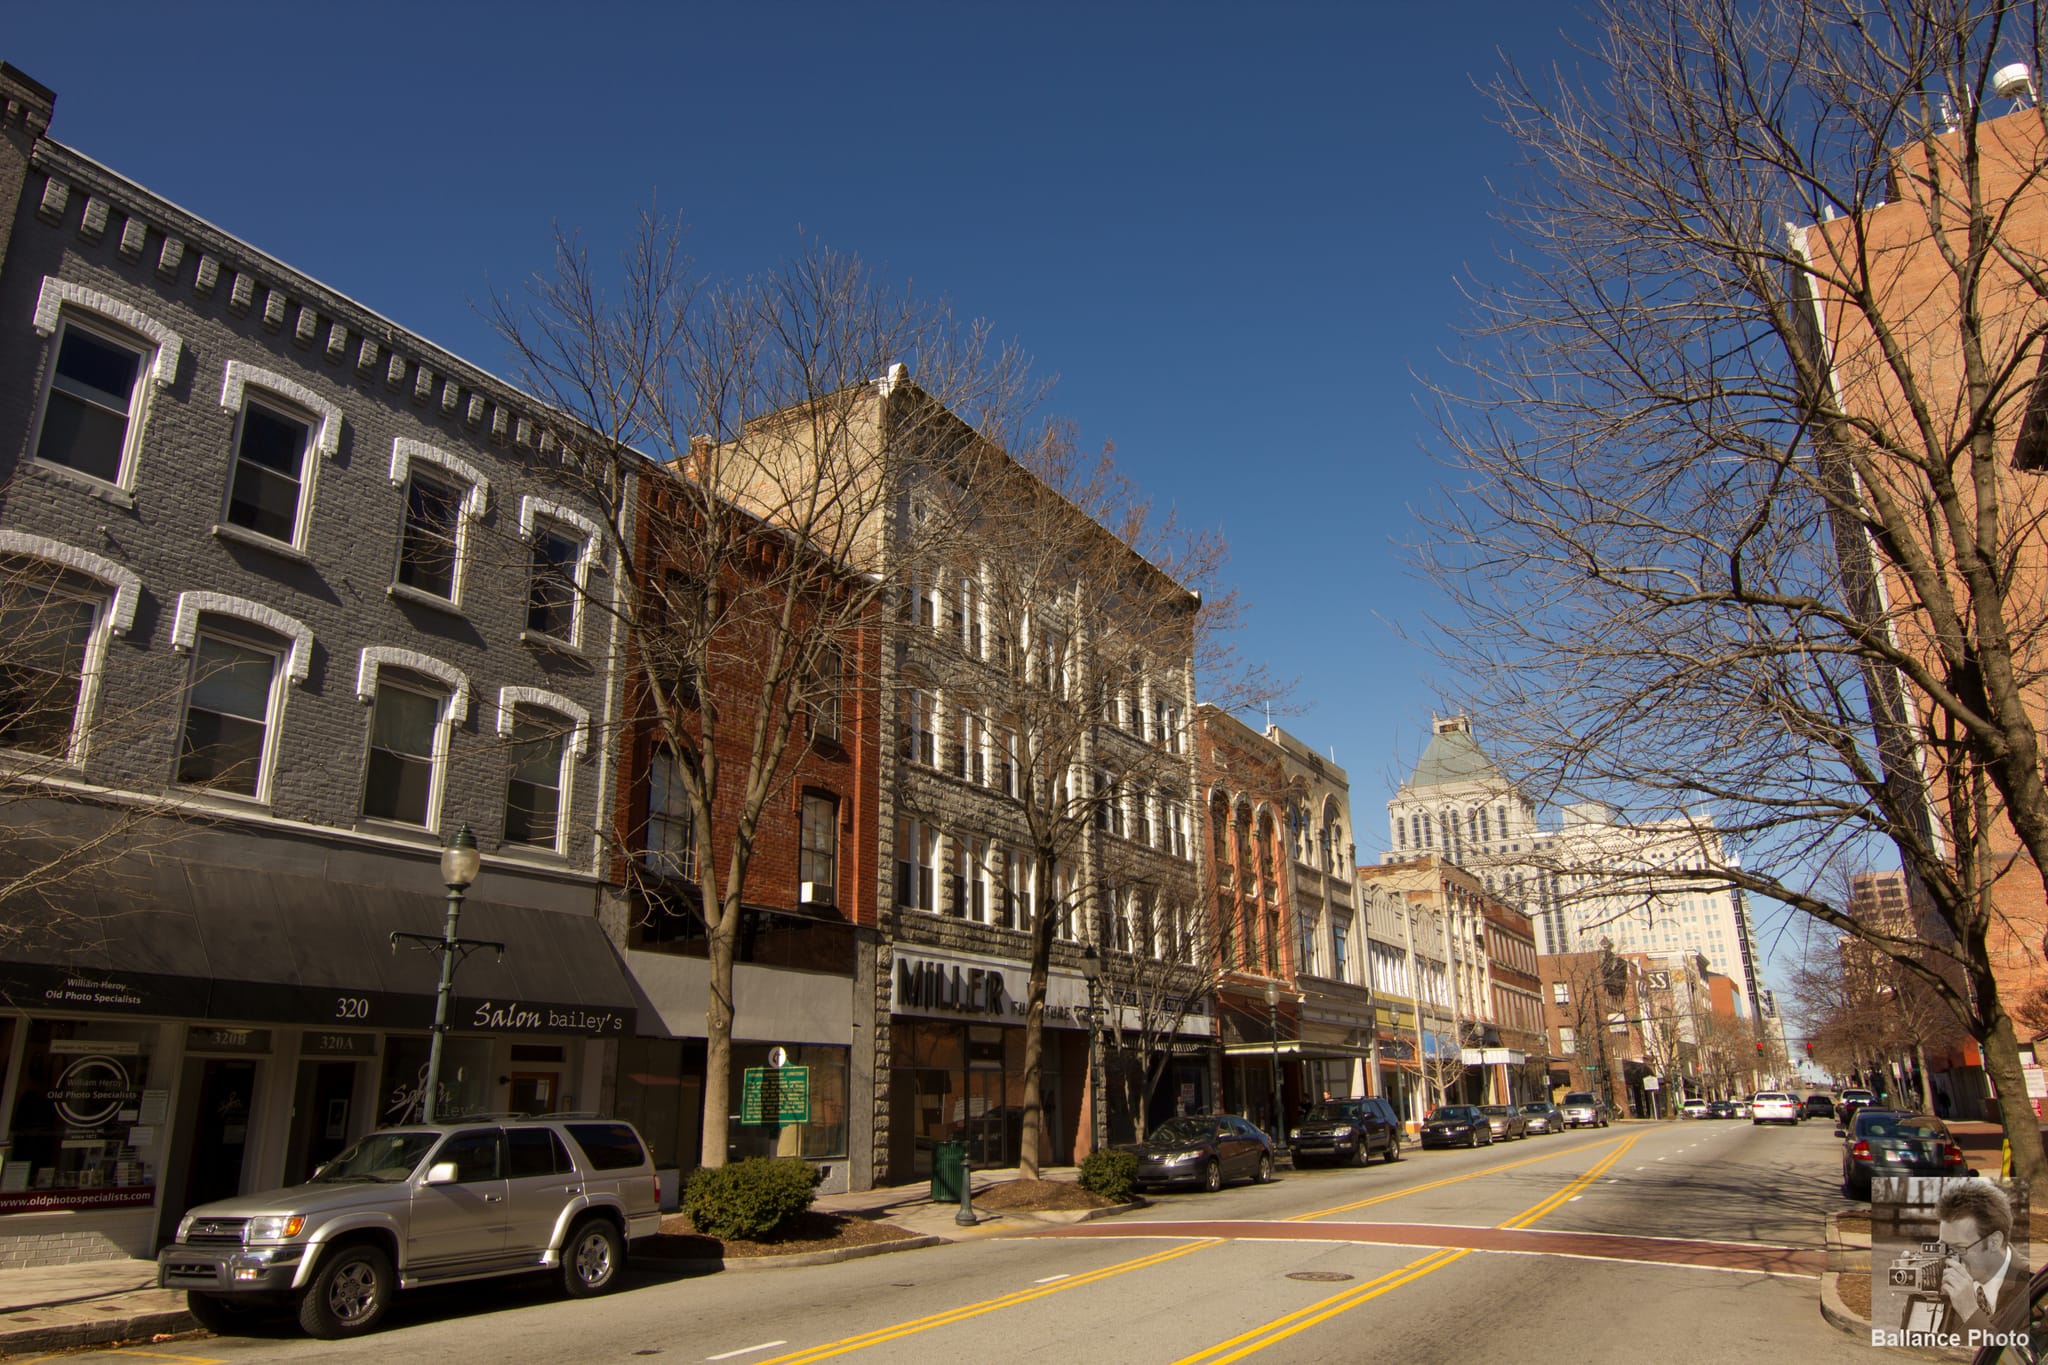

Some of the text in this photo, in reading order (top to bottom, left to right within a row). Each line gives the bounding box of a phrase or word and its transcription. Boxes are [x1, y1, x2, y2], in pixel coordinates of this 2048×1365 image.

[67, 977, 127, 992] William Heroy
[897, 958, 1004, 1015] MILLER
[1011, 1001, 1070, 1021] FUTURE
[45, 990, 142, 1005] Old Photo Specialists
[336, 997, 369, 1019] 320
[473, 1001, 623, 1032] Salon bailey's
[213, 1031, 247, 1046] 320B
[319, 1035, 353, 1050] 320A
[66, 1078, 97, 1087] William
[47, 1090, 137, 1101] Old Photo Specialists
[0, 1192, 151, 1208] www.oldphotospecialists.com
